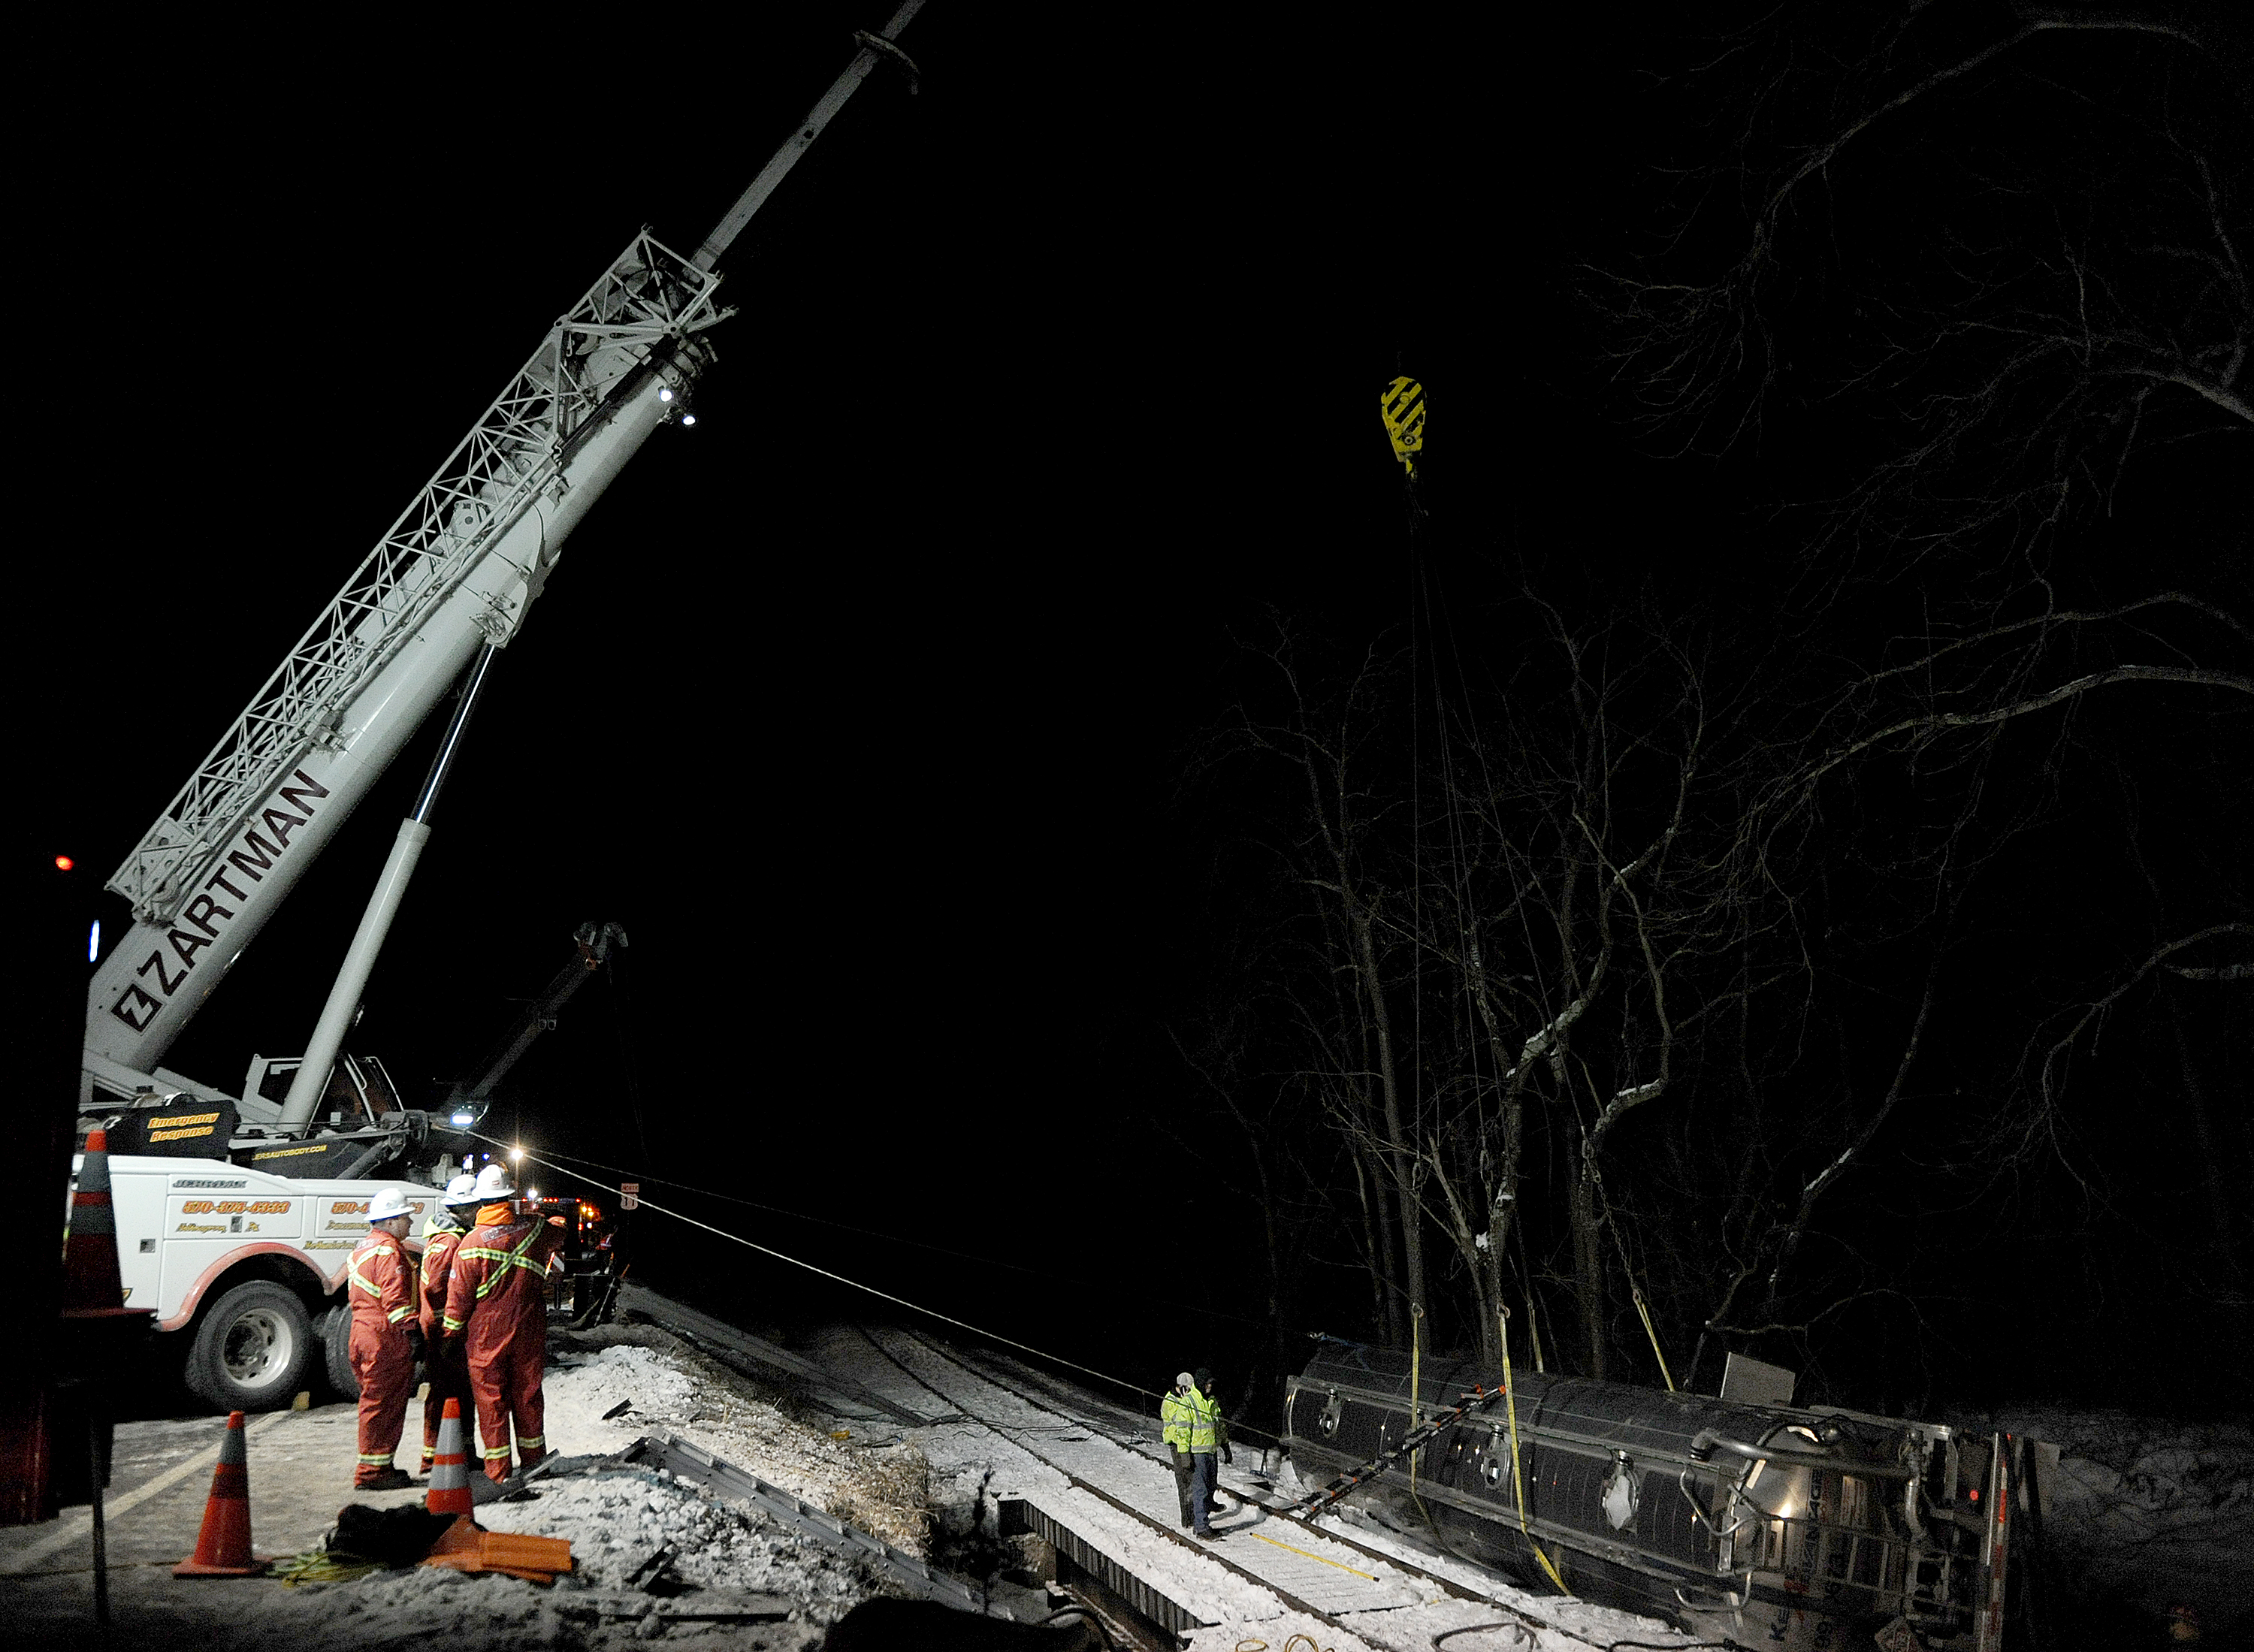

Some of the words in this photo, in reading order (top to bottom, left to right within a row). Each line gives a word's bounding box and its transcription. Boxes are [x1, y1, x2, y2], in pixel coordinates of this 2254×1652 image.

[137, 769, 330, 996] ZARTMAN
[147, 1113, 220, 1128] Emergency
[150, 1126, 214, 1142] Response
[252, 1144, 327, 1161] ERSAUTOBODY.COM
[625, 1196, 635, 1207] 11
